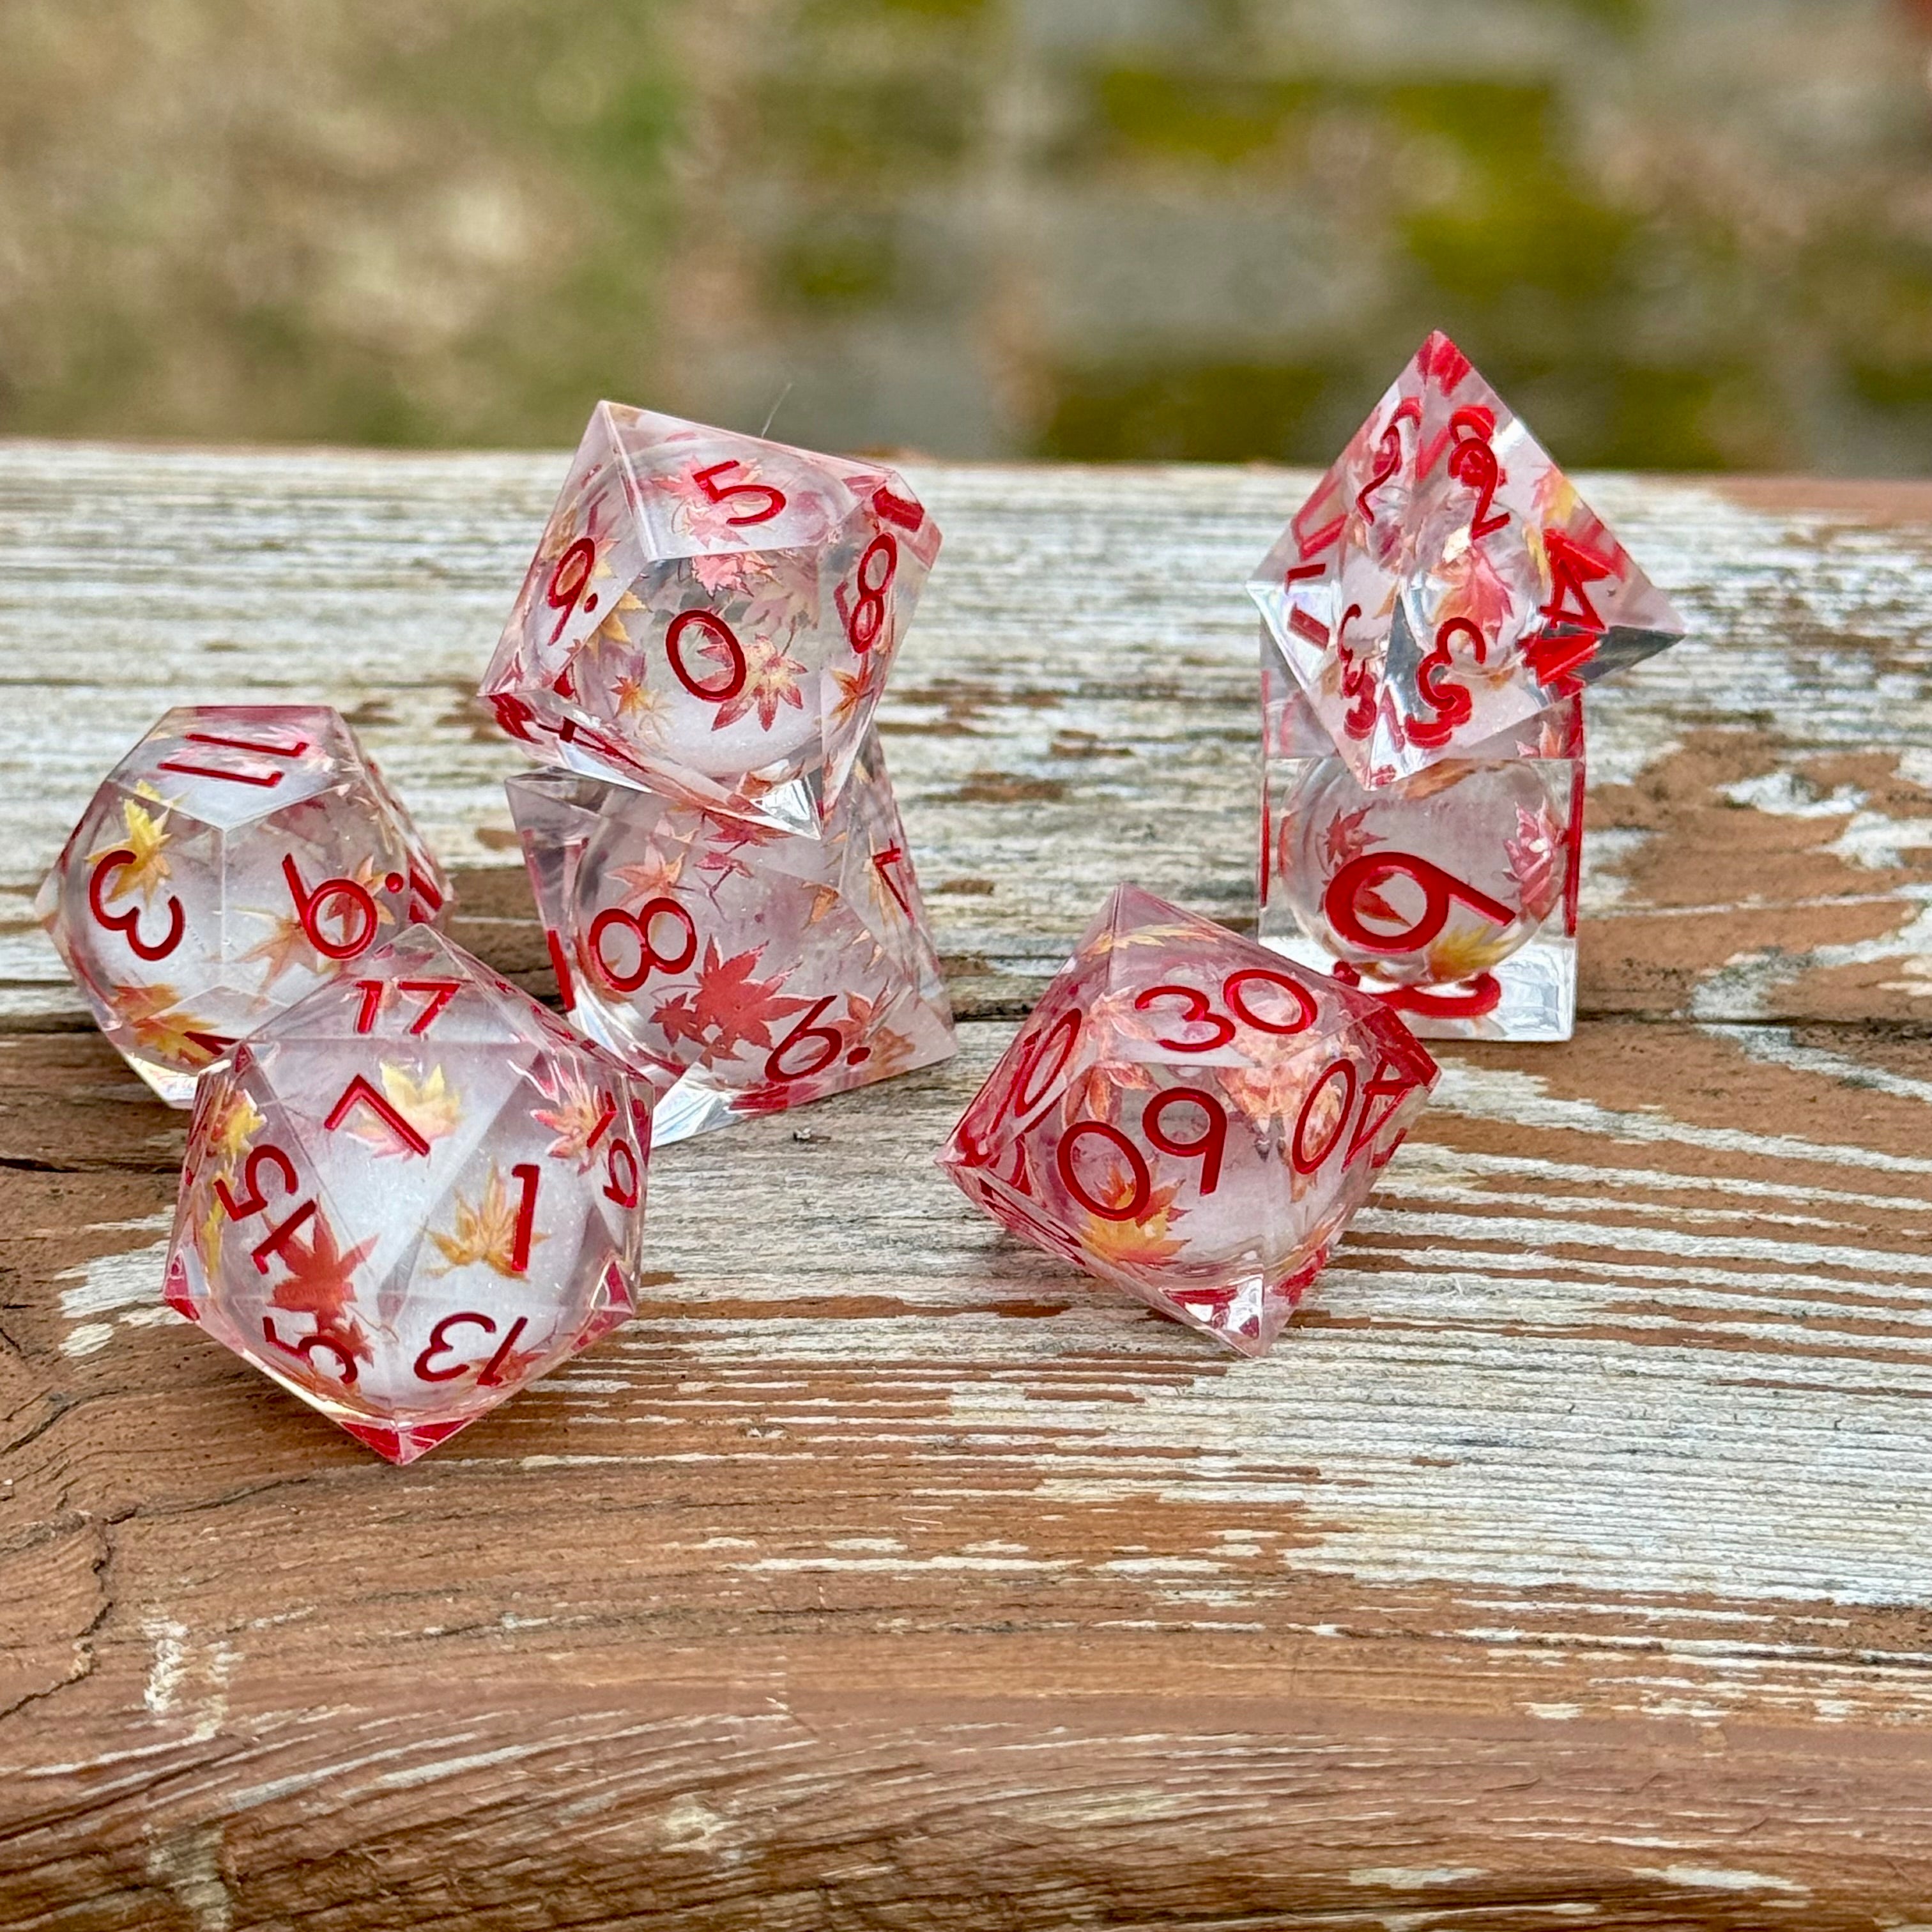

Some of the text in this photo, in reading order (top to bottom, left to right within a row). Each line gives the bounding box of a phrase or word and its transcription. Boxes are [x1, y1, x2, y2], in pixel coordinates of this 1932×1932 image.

[693, 460, 786, 526] 5
[850, 532, 897, 654] 8
[665, 609, 746, 702] 0
[158, 733, 309, 787] 11
[89, 850, 185, 961] 3
[589, 897, 698, 992] 8
[355, 980, 463, 1034] 17
[1133, 969, 1318, 1053] 30
[324, 1075, 430, 1156] 7
[213, 1144, 318, 1275] 15
[512, 1164, 539, 1272] 1
[262, 1316, 358, 1384] 5
[414, 1312, 528, 1386] 13
